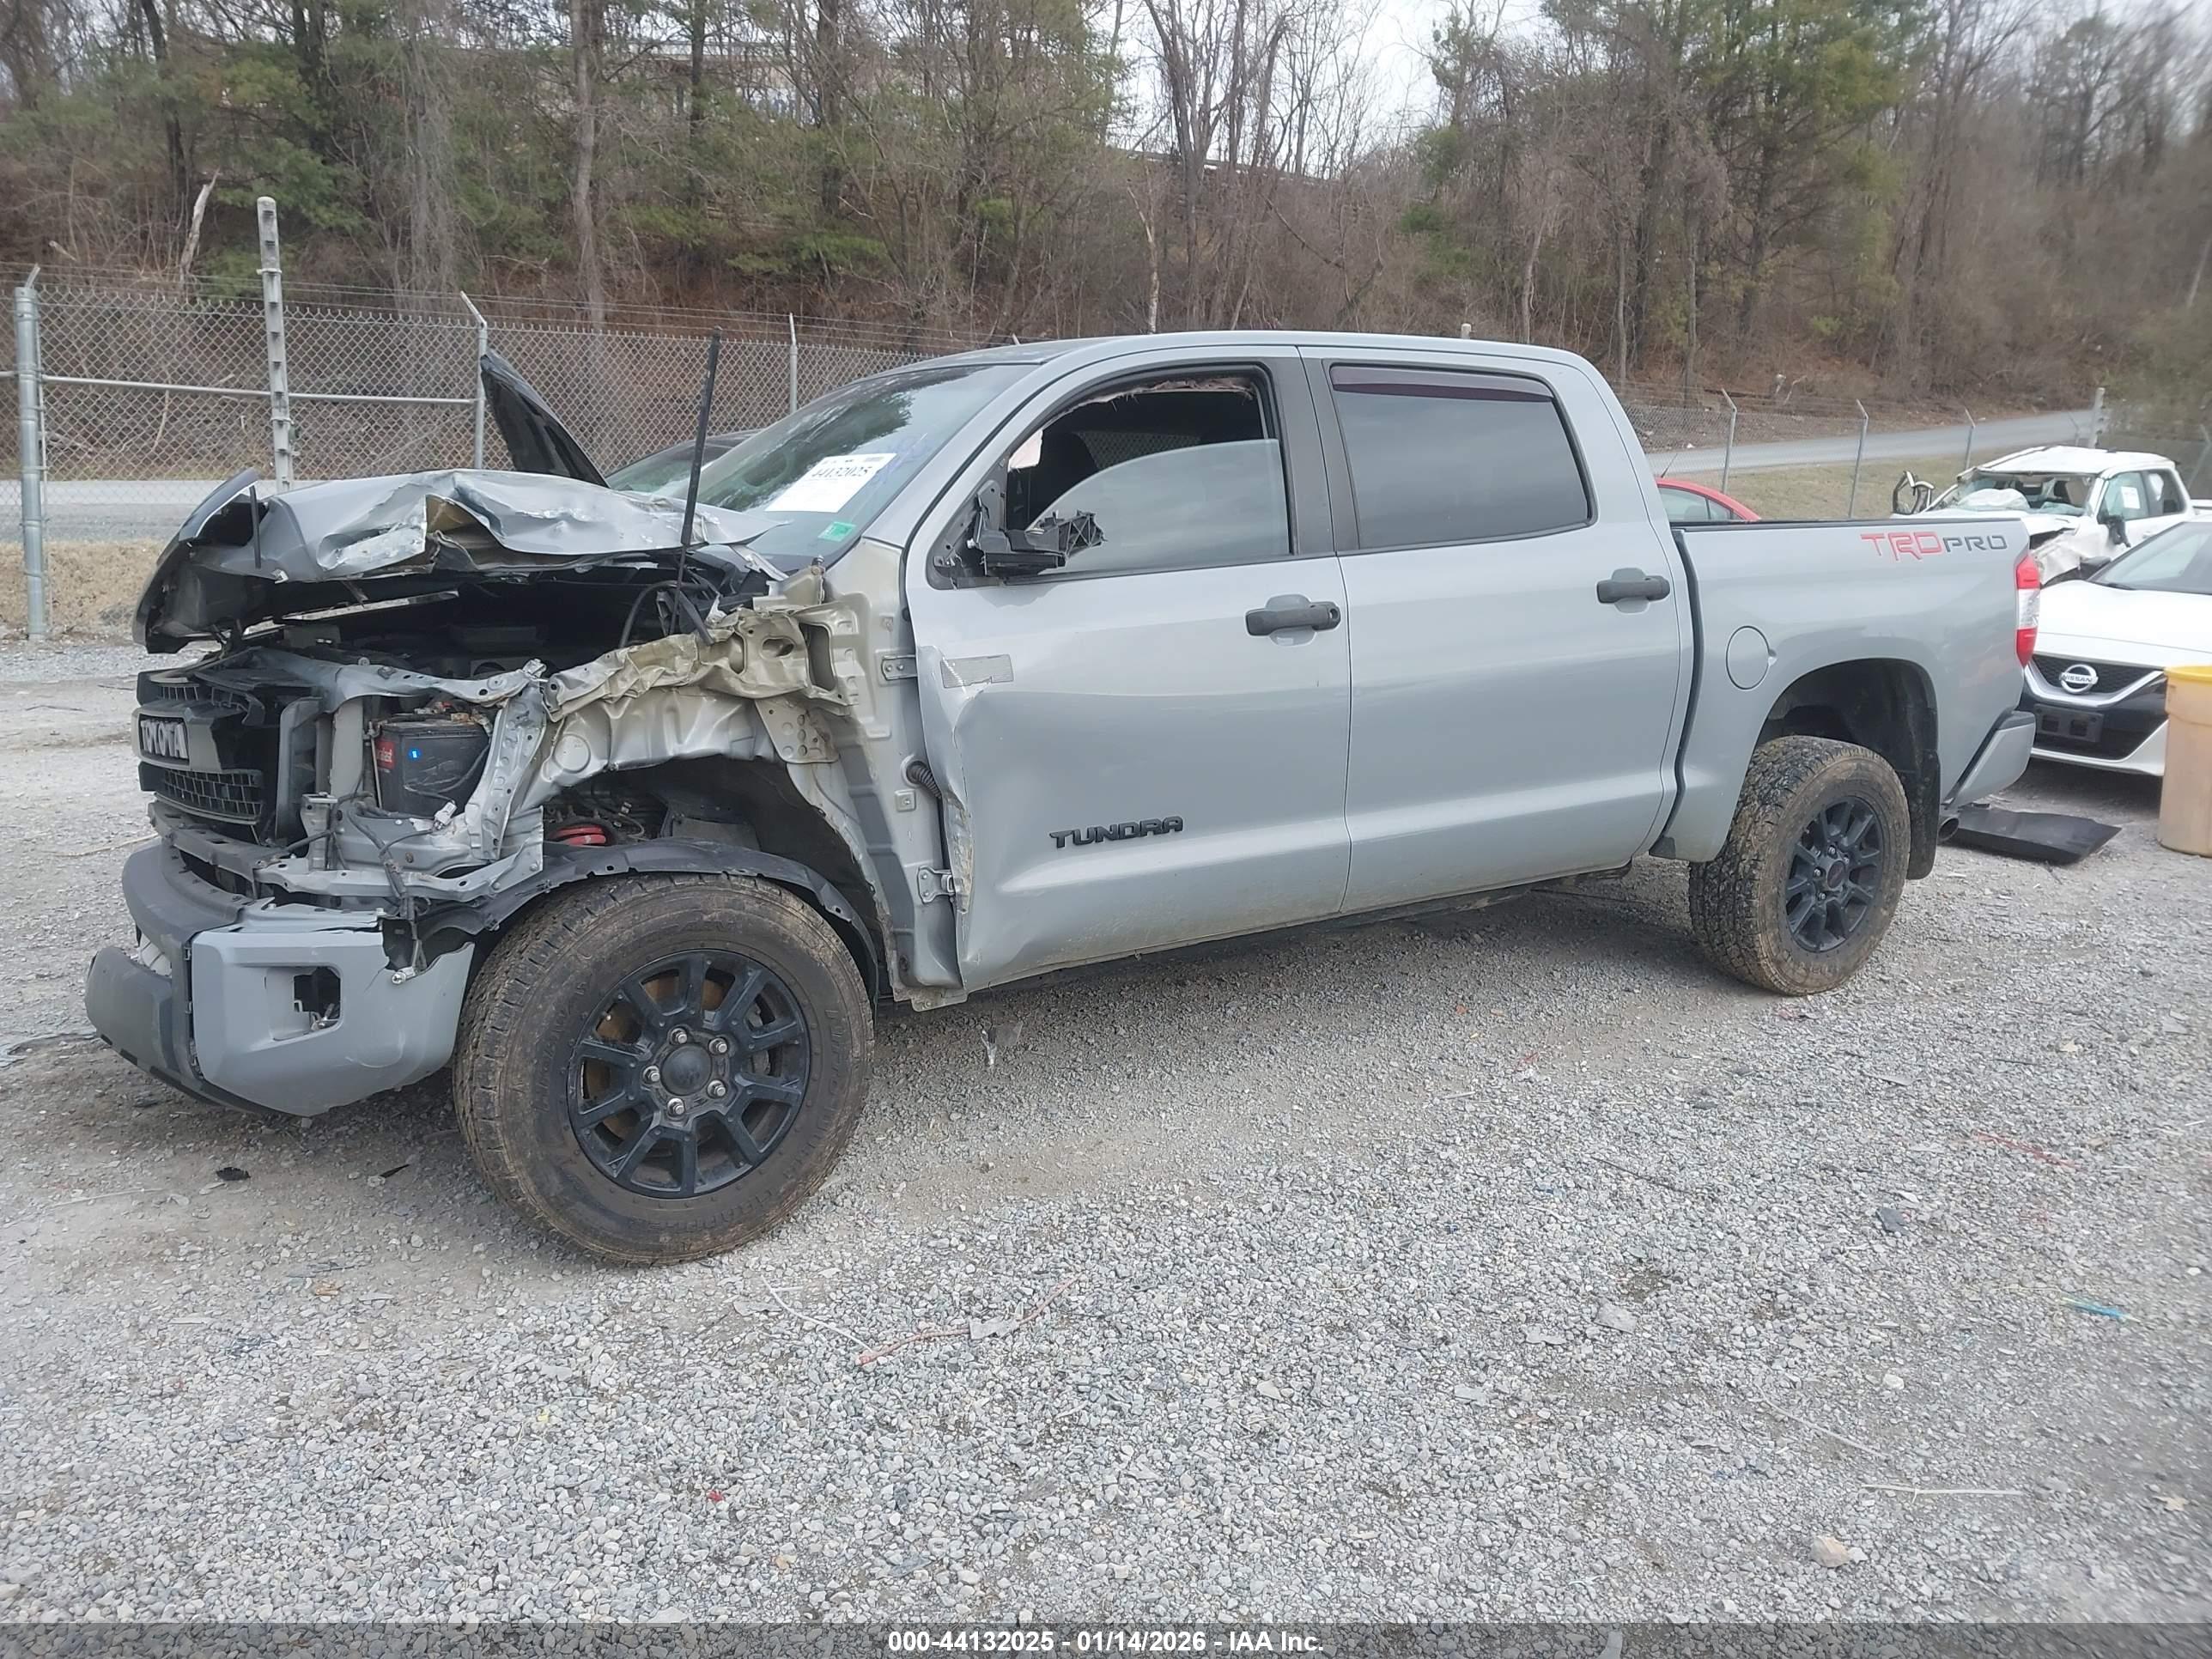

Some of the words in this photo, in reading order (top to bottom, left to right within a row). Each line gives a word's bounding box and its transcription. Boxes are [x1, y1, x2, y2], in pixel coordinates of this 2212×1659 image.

[1860, 532, 1942, 562] TRD
[1942, 535, 2008, 552] PRO
[2061, 673, 2094, 684] NISSAN
[140, 719, 189, 759] TOYOTA
[1048, 815, 1184, 849] TUNDRA
